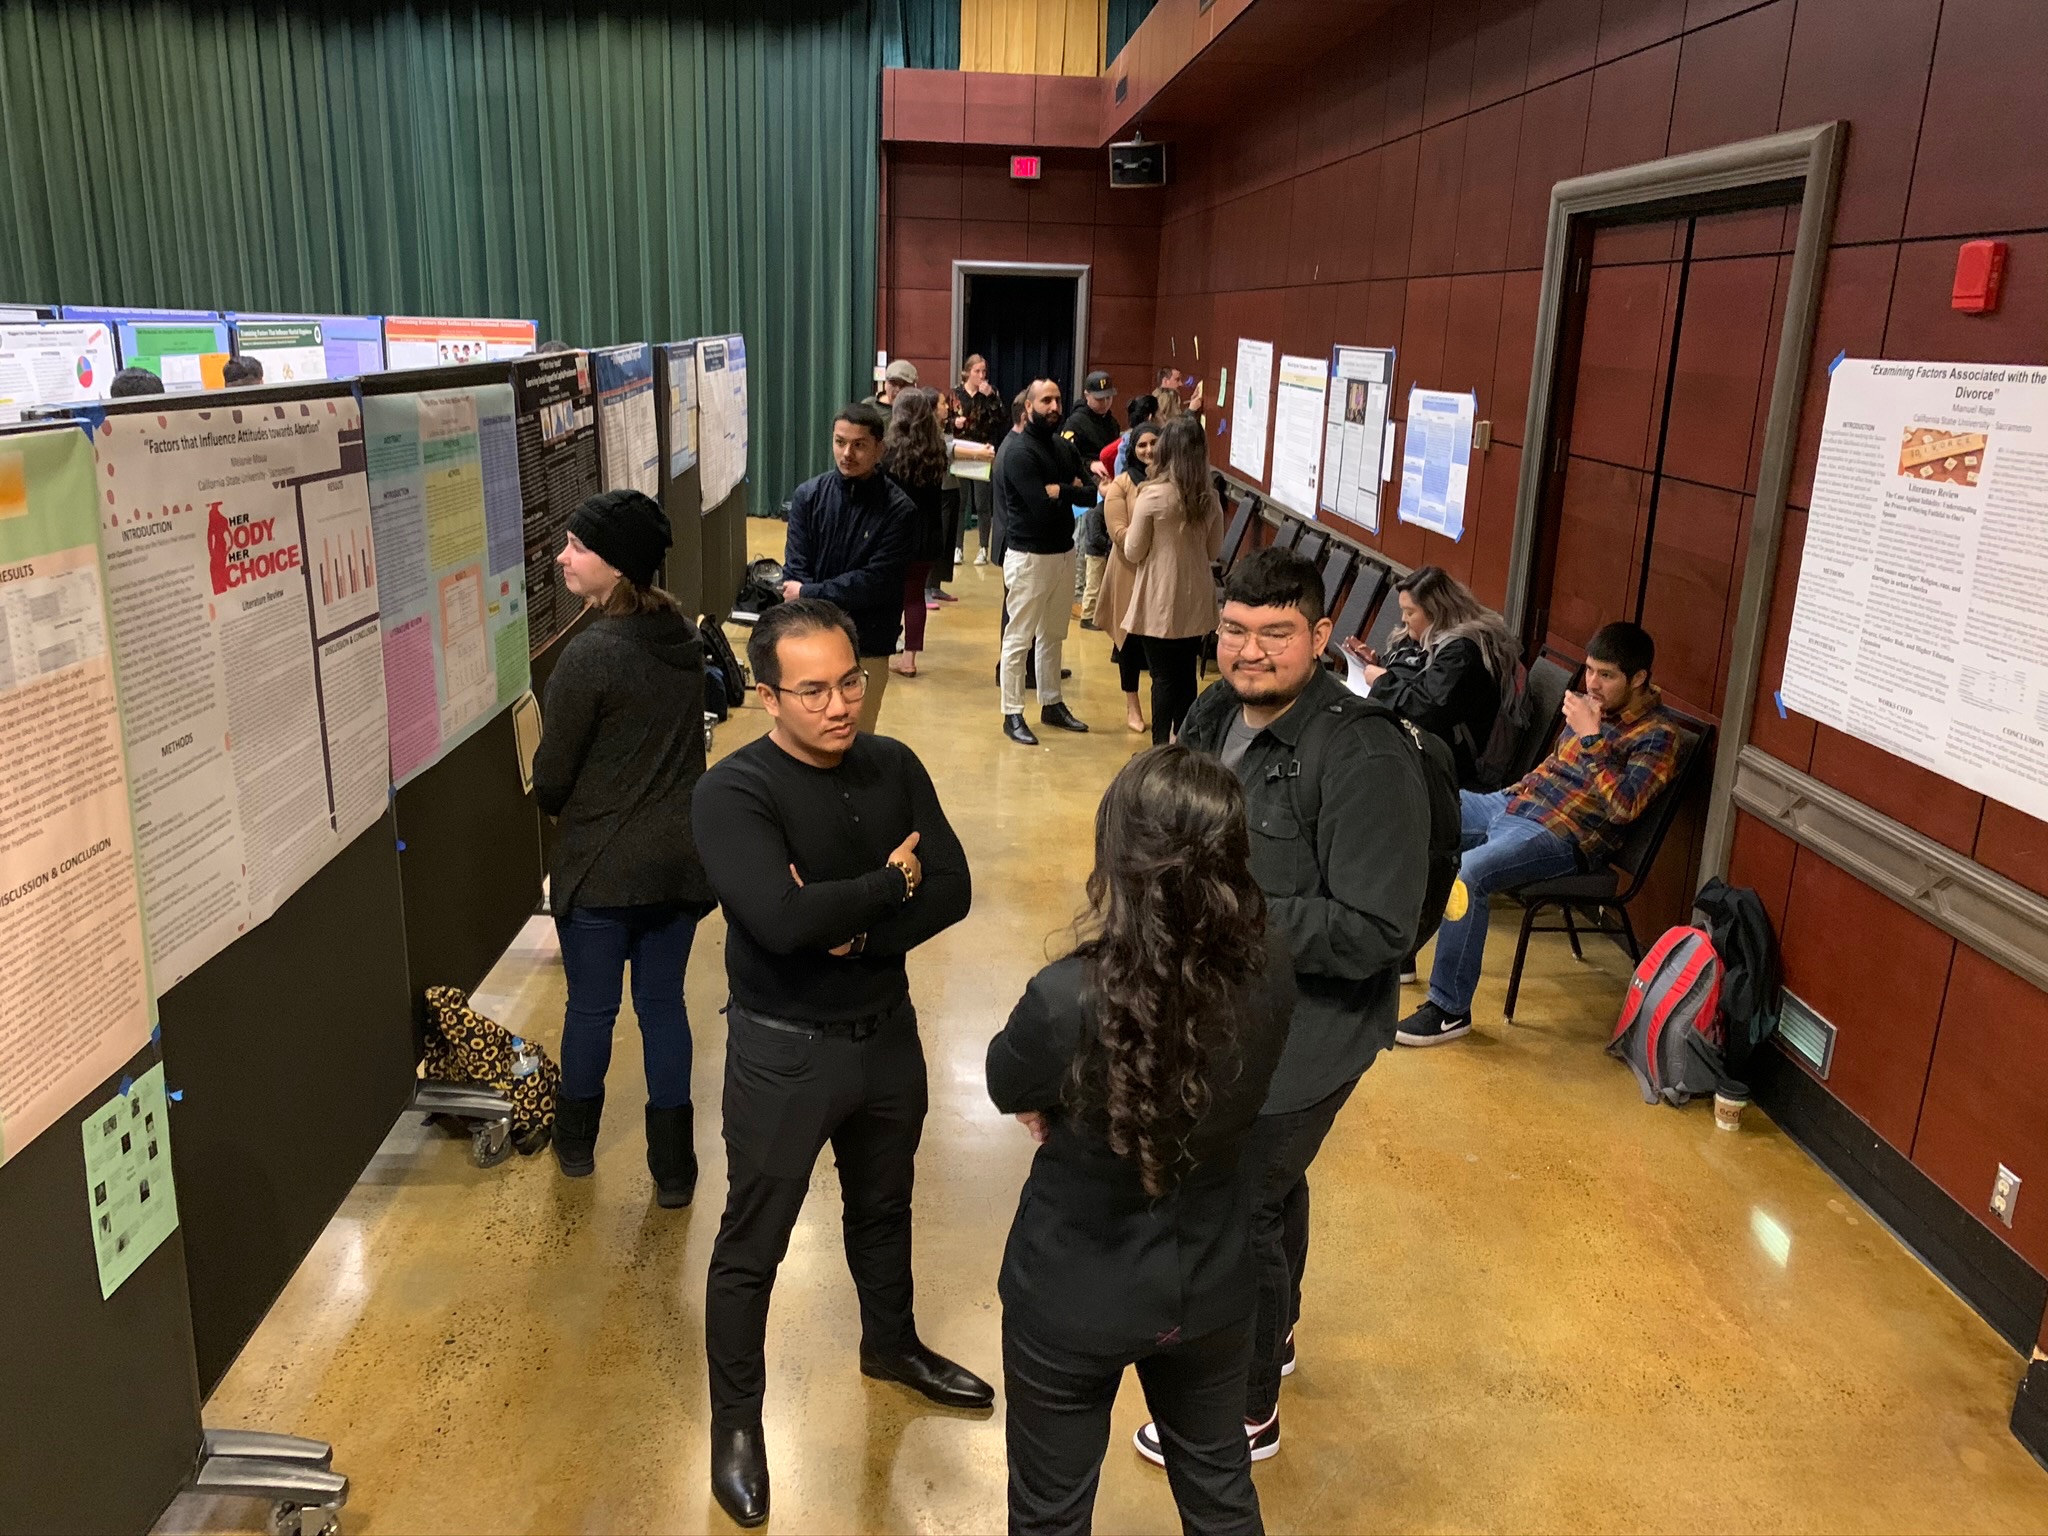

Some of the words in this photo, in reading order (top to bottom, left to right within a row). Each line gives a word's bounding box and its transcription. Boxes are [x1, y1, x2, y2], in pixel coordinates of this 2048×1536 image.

[1916, 366, 1947, 380] Factors
[1949, 367, 2004, 382] Associated
[2007, 371, 2028, 384] with
[2031, 372, 2047, 384] the
[1100, 379, 1106, 389] P
[1955, 386, 2000, 401] Divorce”
[1952, 404, 1978, 414] Manuel
[1842, 422, 1875, 431] INTRODUCTION
[1913, 413, 1940, 425] California
[1941, 415, 1957, 426] State
[1958, 416, 1990, 430] University
[1995, 421, 2032, 433] Sacramento
[181, 436, 198, 450] that
[200, 432, 236, 448] Influence
[237, 427, 269, 443] Attitudes
[269, 426, 294, 439] towards
[198, 477, 225, 490] California
[225, 476, 240, 486] State
[1908, 483, 1936, 496] Literature
[1937, 488, 1959, 499] Review
[1942, 501, 1977, 515] Understanding
[229, 513, 250, 527] HER
[122, 520, 173, 542] INTRODUCTION
[228, 549, 250, 563] HER
[225, 544, 301, 588] CHOICE
[1823, 568, 1845, 578] METHODS
[1910, 584, 1928, 594] America
[242, 596, 266, 611] Literature
[266, 590, 284, 601] Review
[1879, 633, 1894, 643] Gender
[1916, 645, 1932, 655] Higher
[1932, 650, 1954, 663] Education
[88, 674, 105, 685] almost
[57, 691, 88, 710] unemployed
[1878, 697, 1895, 710] WORKS
[1896, 704, 1913, 716] CITED
[79, 722, 108, 738] relationship
[2003, 726, 2044, 748] CONCLUSION
[161, 732, 194, 757] METHODS
[51, 867, 58, 879] &
[60, 837, 112, 874] CONCLUSION
